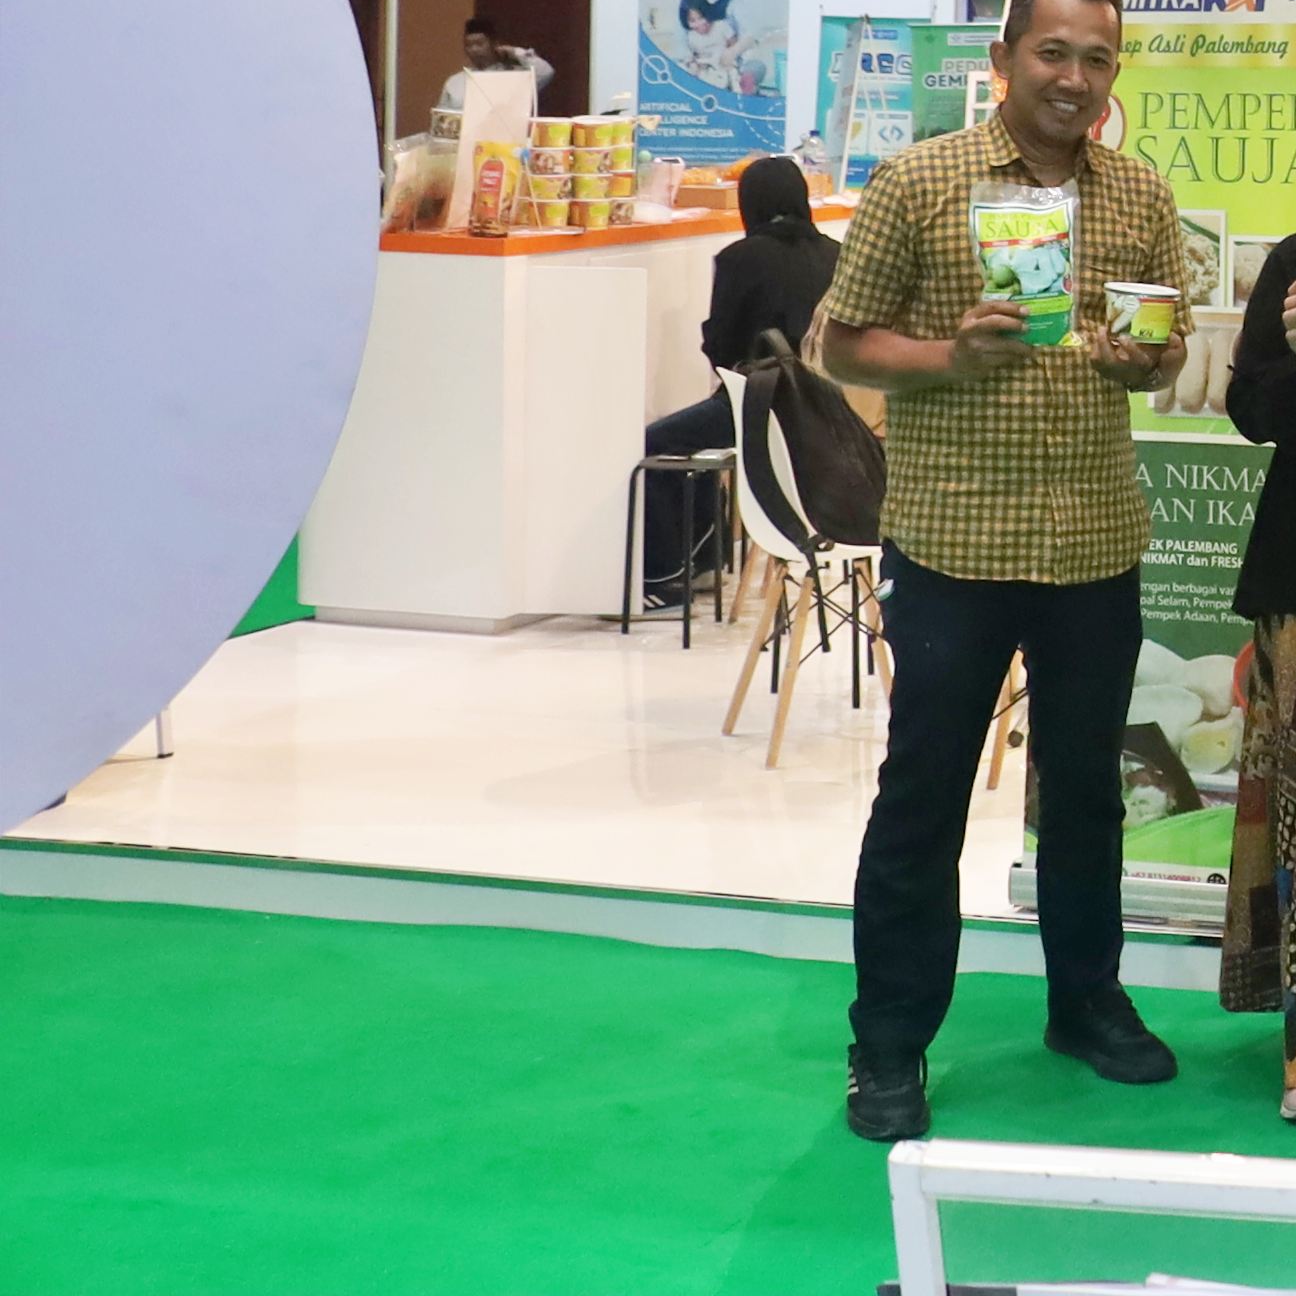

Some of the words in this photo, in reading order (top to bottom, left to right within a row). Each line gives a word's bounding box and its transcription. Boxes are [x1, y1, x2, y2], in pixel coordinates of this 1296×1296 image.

[1148, 34, 1185, 54] Asli
[1190, 34, 1289, 58] Palembang
[1164, 463, 1267, 493] NIKMA
[1206, 499, 1256, 527] IKA
[1165, 538, 1238, 555] PALEMBANG
[1187, 555, 1209, 568] dan
[1172, 582, 1218, 597] berbagai
